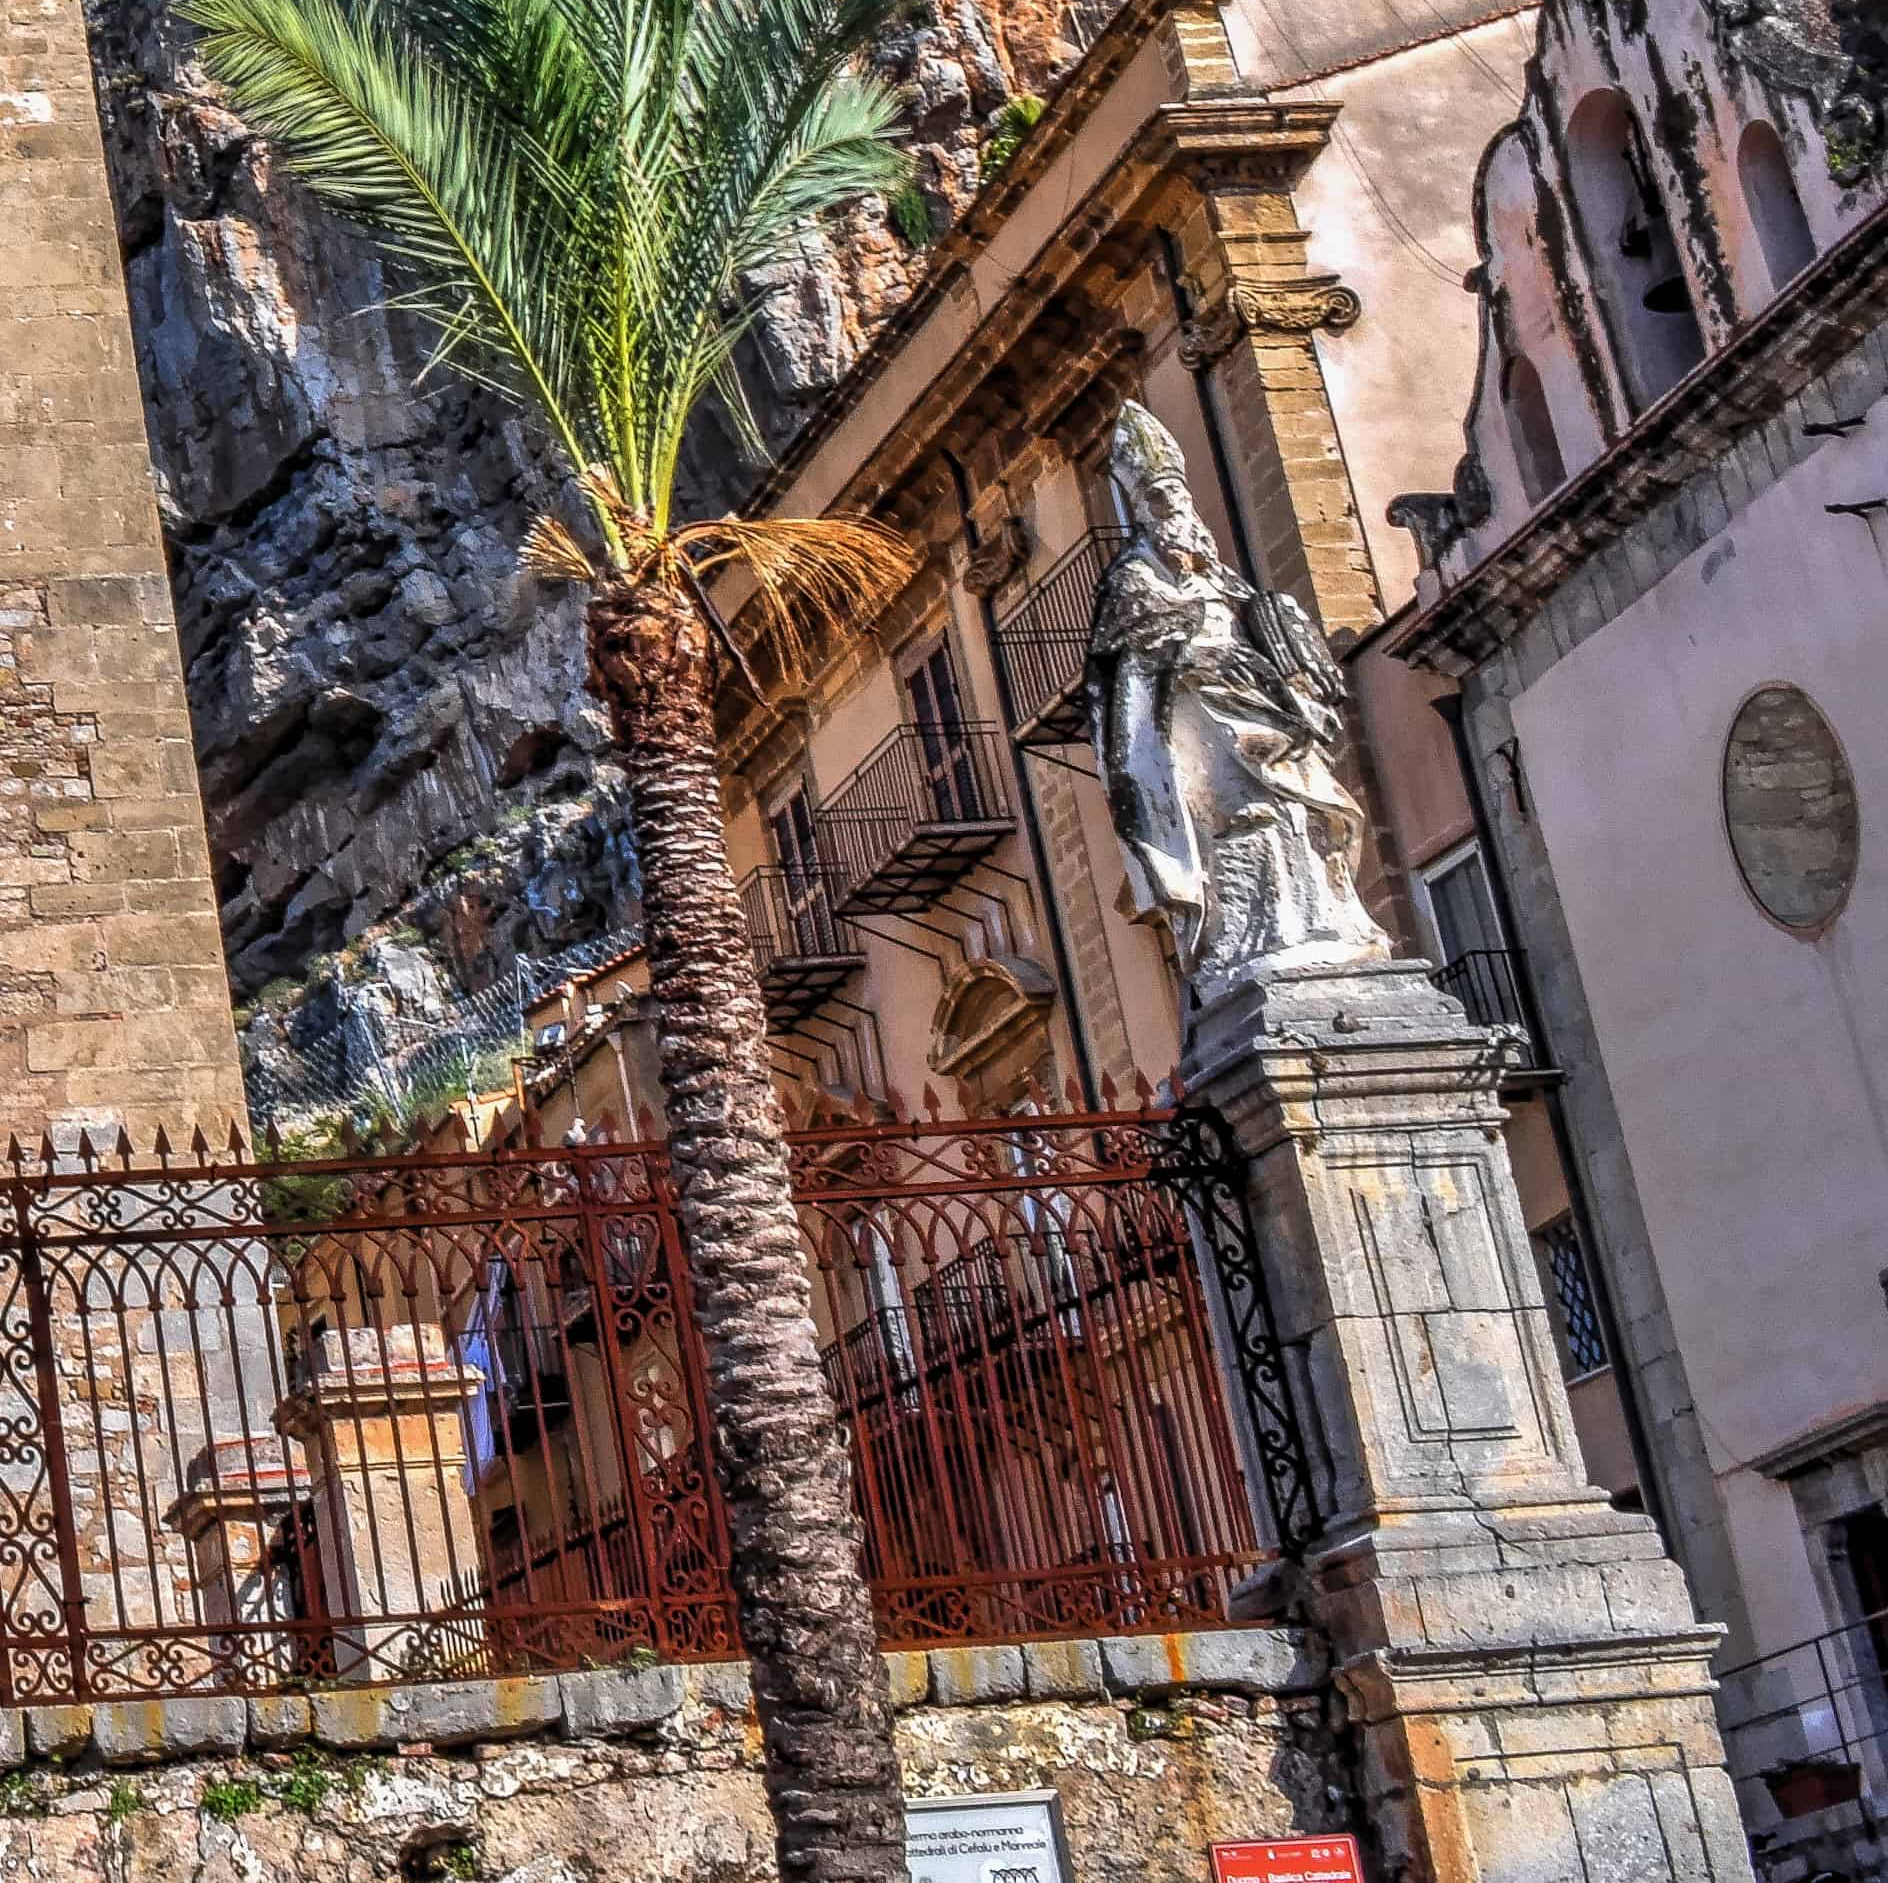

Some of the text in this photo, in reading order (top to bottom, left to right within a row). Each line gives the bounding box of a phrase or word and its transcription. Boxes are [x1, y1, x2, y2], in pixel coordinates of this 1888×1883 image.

[910, 1827, 1024, 1841] ermo arabo-normanna
[906, 1844, 946, 1857] attedrali
[948, 1843, 958, 1855] di
